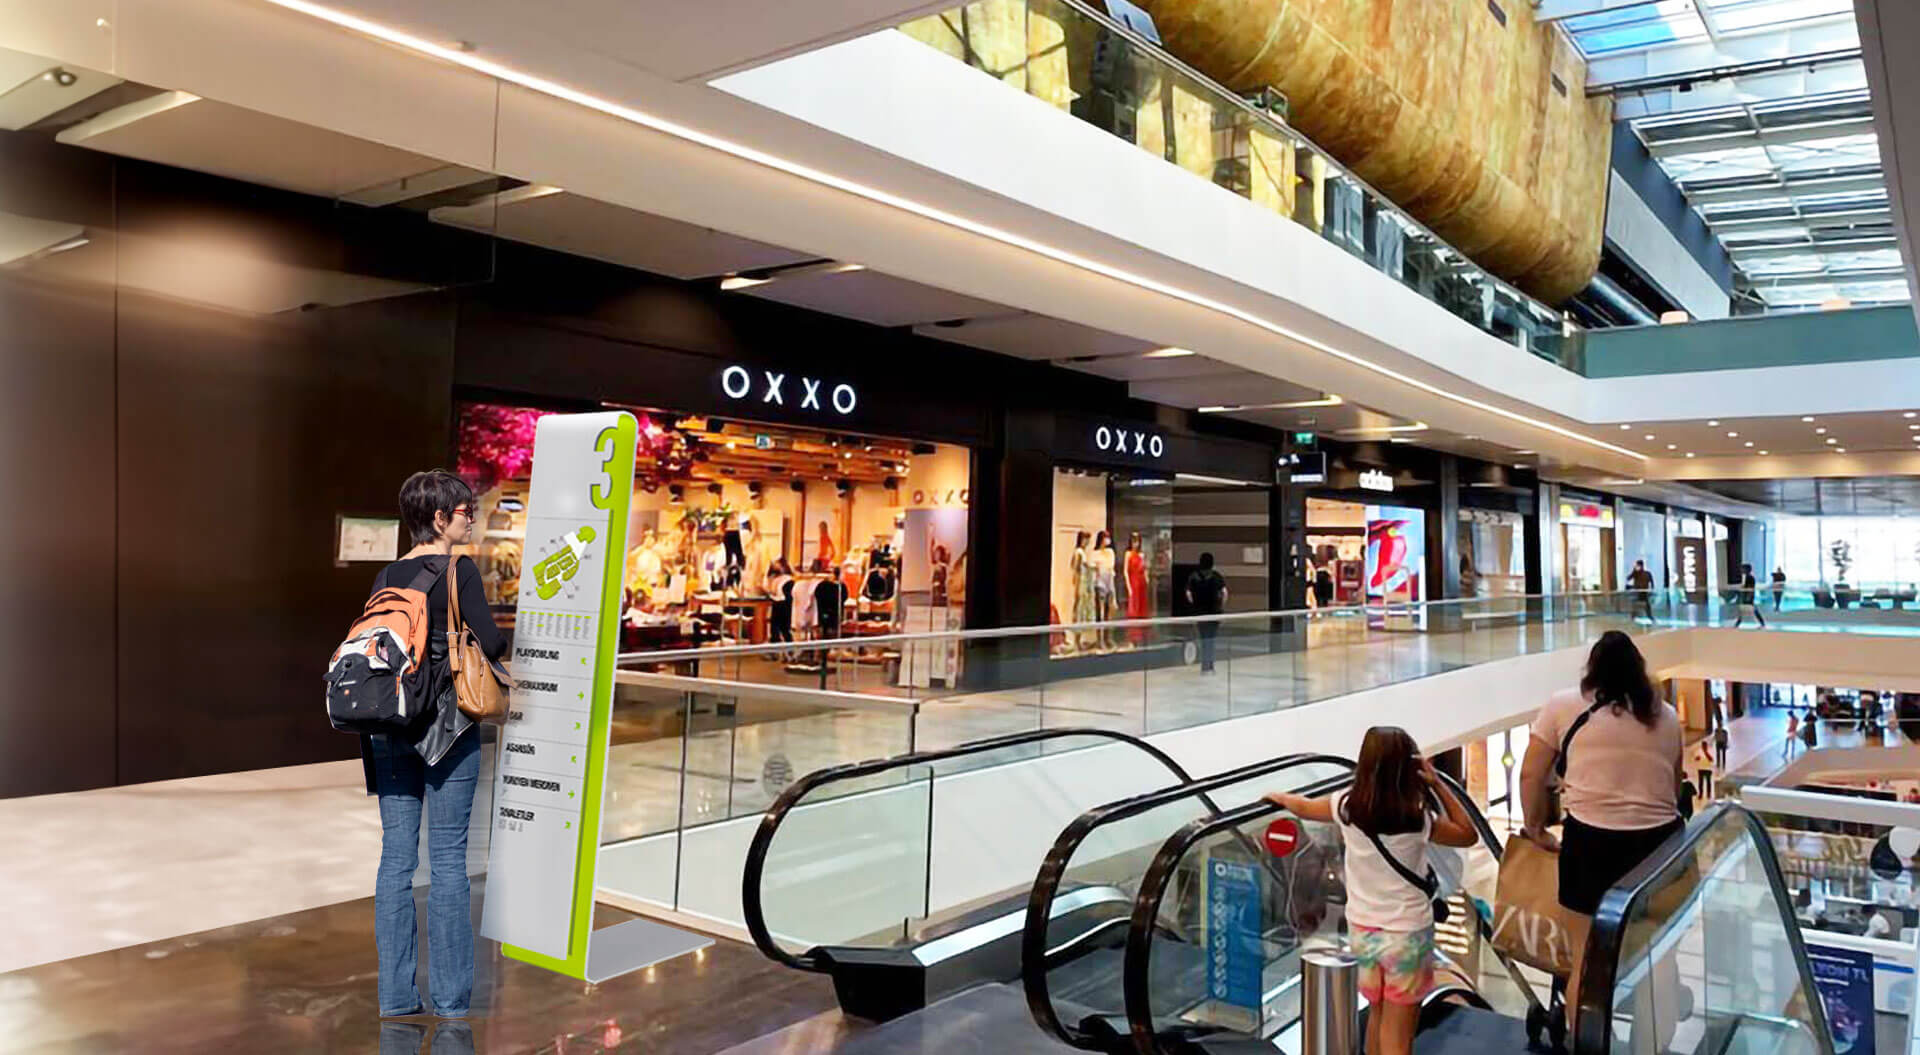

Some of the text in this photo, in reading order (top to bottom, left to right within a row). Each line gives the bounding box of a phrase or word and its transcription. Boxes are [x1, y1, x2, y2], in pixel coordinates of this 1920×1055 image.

[722, 365, 857, 414] OXXO
[1095, 426, 1163, 458] OXXO
[589, 425, 624, 510] 3
